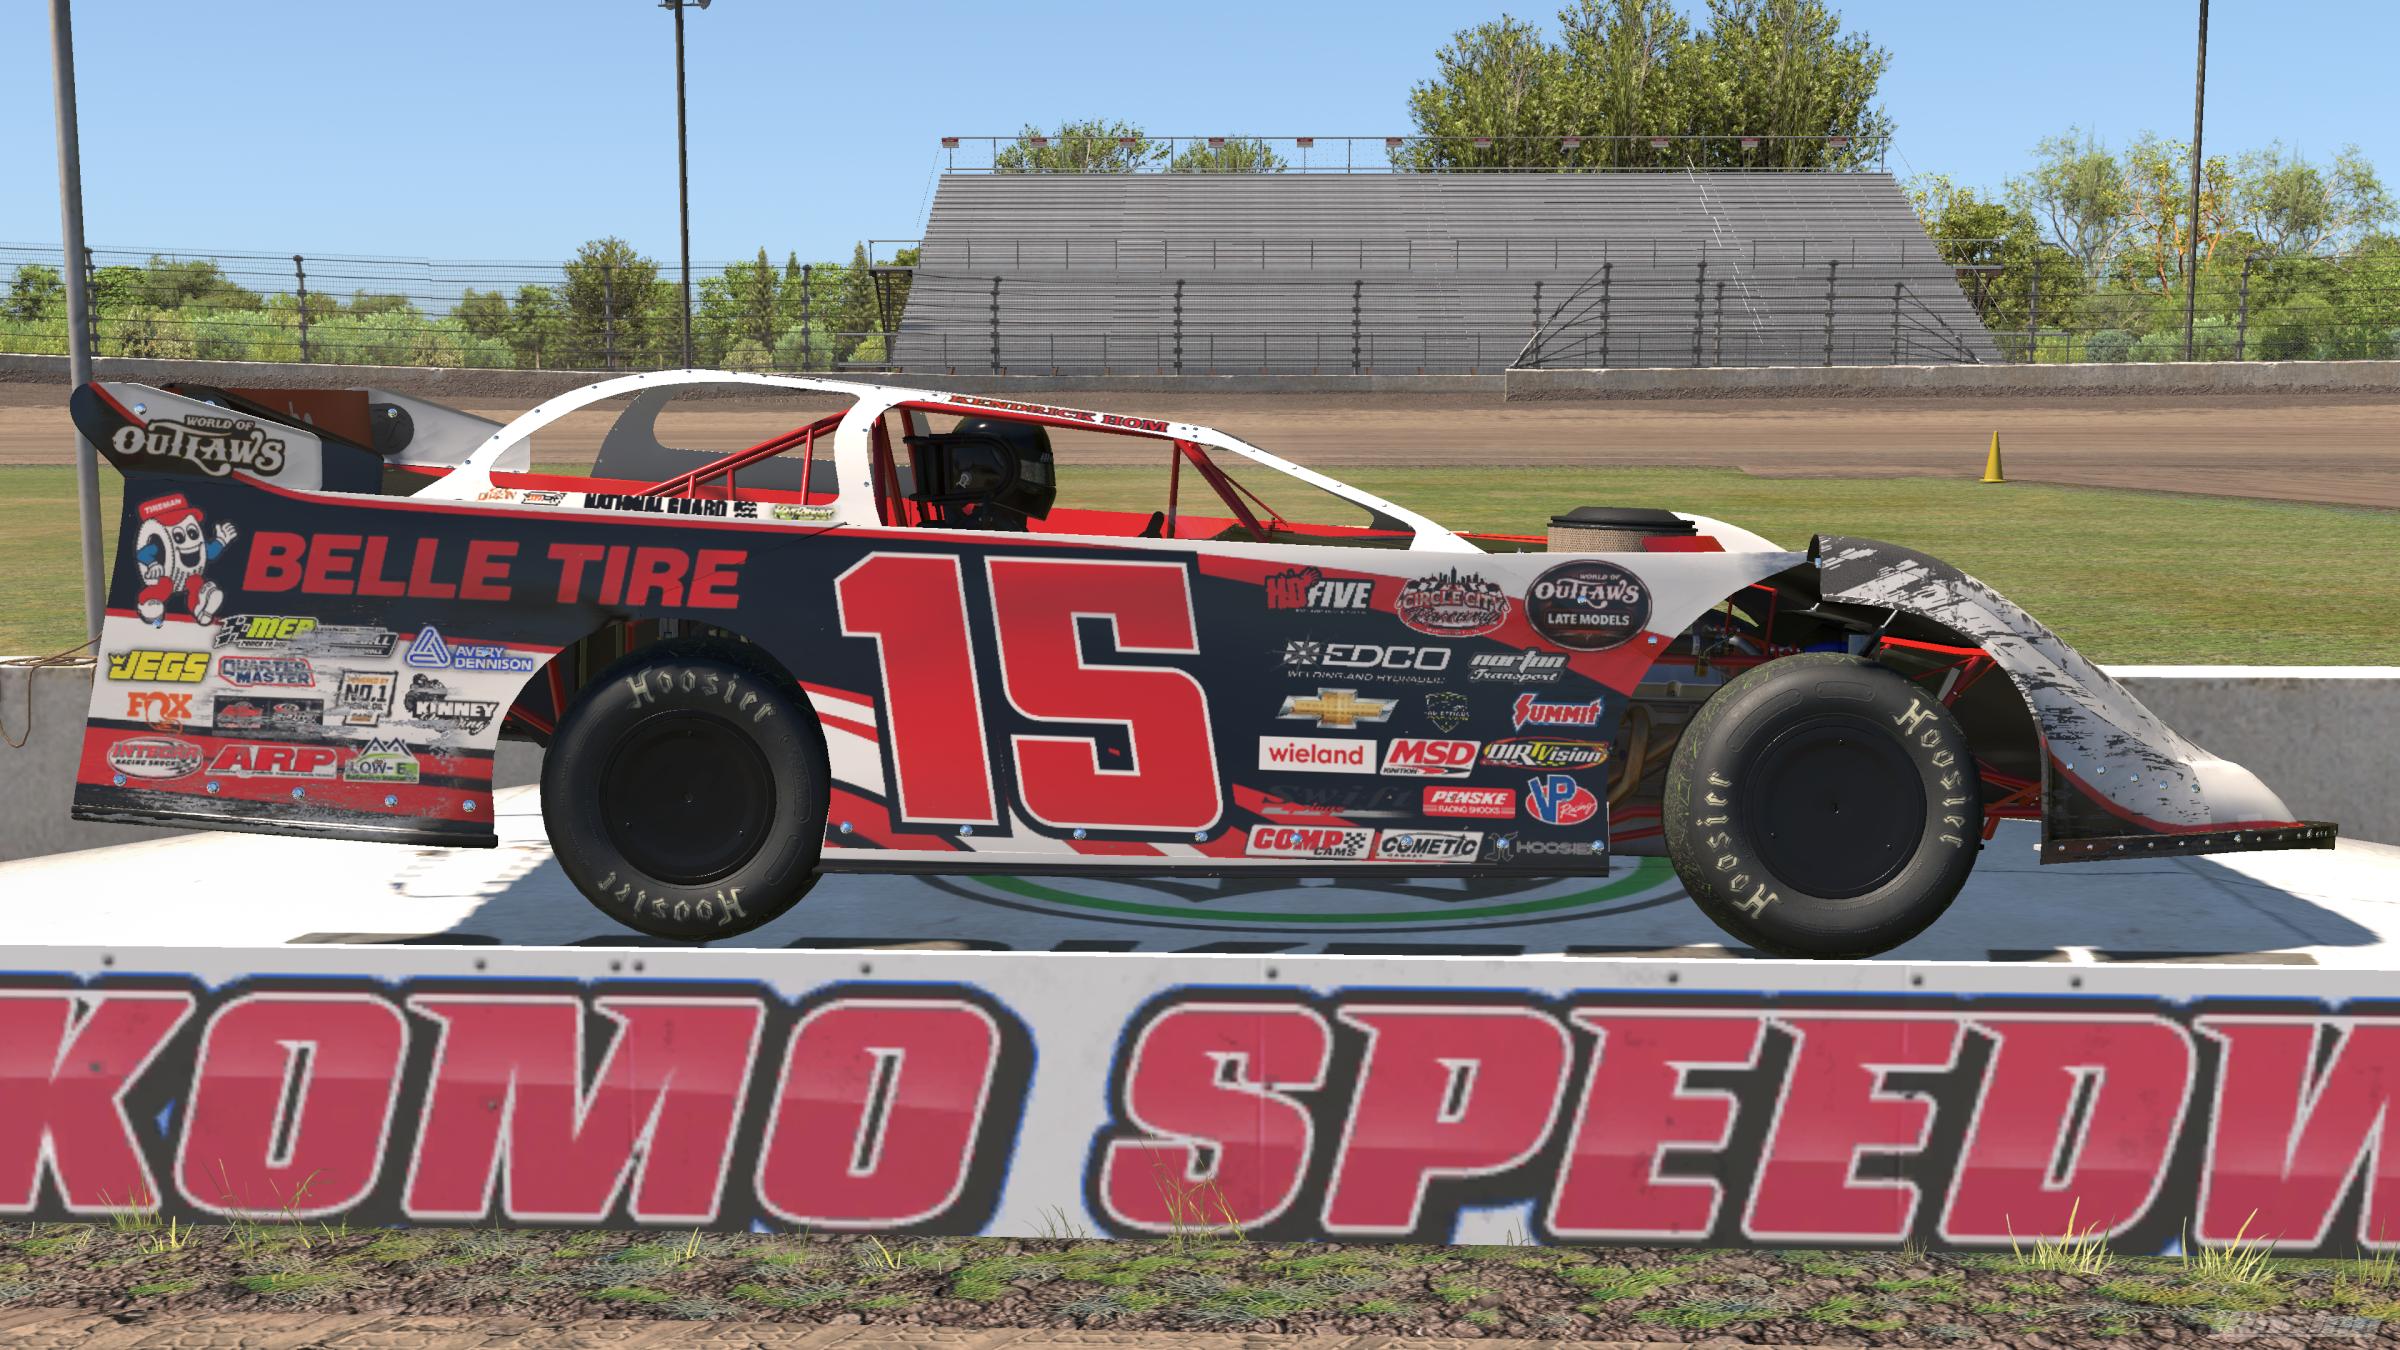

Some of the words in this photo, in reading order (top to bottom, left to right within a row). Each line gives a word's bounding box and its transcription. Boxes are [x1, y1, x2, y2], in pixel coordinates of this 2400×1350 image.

[186, 416, 232, 430] WORLD
[233, 420, 255, 431] OF
[949, 395, 1097, 422] KENDRICK
[1101, 414, 1170, 433] HOM
[112, 422, 284, 477] OUTLAWS
[143, 498, 182, 515] TIREMAN
[243, 531, 519, 601] BELLE
[547, 543, 748, 609] TIRE
[1307, 580, 1373, 609] FIVE
[1403, 590, 1461, 608] CIRCLE
[1464, 592, 1504, 612] CITY
[1535, 578, 1639, 609] OUTLAWS
[246, 617, 317, 640] MEP
[1547, 613, 1577, 625] LATE
[1579, 613, 1630, 626] MODELS
[109, 650, 211, 682] JEGS
[222, 659, 306, 677] QUARTER
[454, 658, 533, 671] DENNISON
[1322, 643, 1451, 671] EDCO
[235, 671, 310, 685] MASTER
[1346, 673, 1374, 681] AND
[1470, 668, 1558, 682] Transport
[626, 665, 777, 723] Hoosier
[834, 551, 1223, 833] 15
[127, 691, 193, 720] FOX
[416, 701, 497, 718] KINNEY
[112, 743, 200, 760] INTEGRA
[211, 746, 336, 773] ARP
[1268, 742, 1364, 765] wieland
[1389, 740, 1476, 766] MSD
[1383, 767, 1418, 775] IGNITION
[1893, 698, 1967, 848] Hoosier
[1431, 790, 1509, 805] PENSKE
[1527, 774, 1577, 824] VP
[1438, 805, 1467, 813] RACING
[1469, 806, 1501, 814] SHOCKS
[1559, 802, 1594, 818] Racing
[1253, 828, 1345, 851] COMP
[1382, 835, 1478, 856] COMETIC
[1696, 768, 1784, 920] Hoosier
[1313, 846, 1357, 857] CAMS
[598, 870, 747, 926] Hoosier
